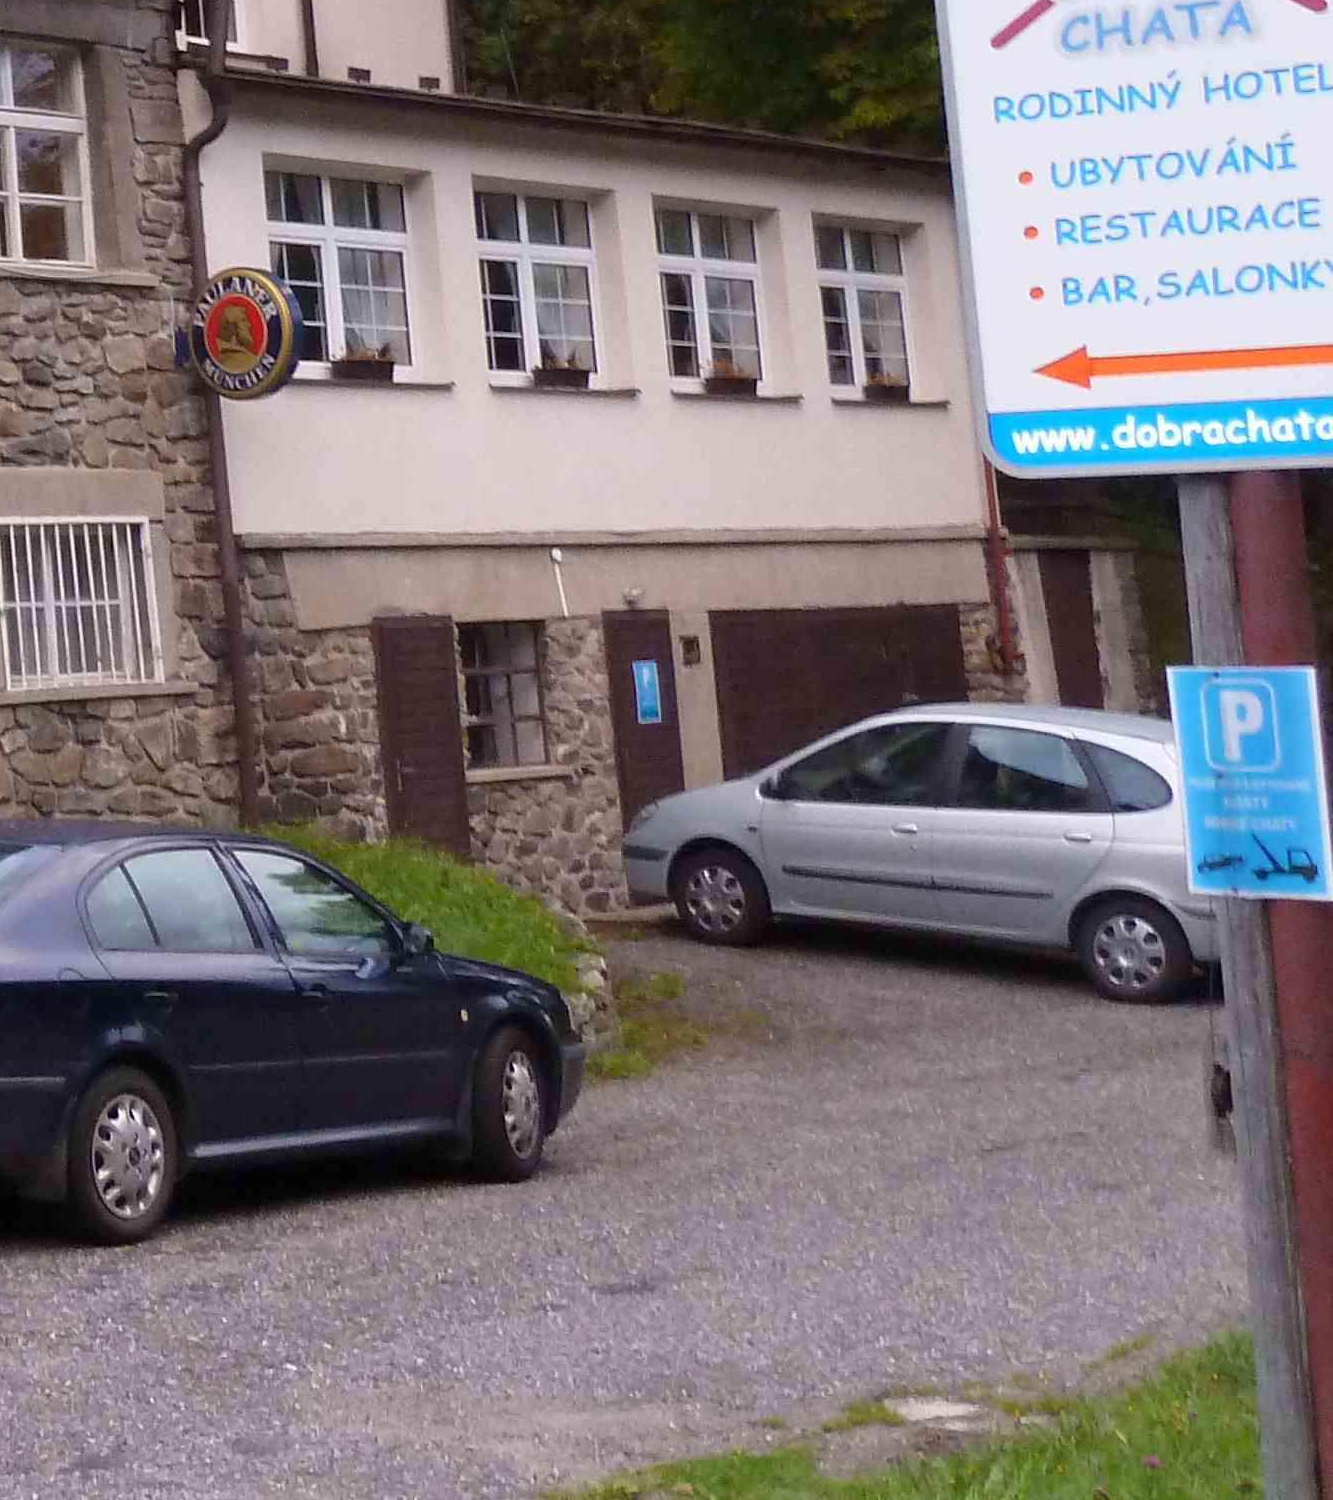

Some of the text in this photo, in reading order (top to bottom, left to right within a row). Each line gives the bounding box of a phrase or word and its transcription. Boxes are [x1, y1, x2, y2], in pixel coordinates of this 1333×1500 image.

[1060, 0, 1254, 54] CHATA
[992, 63, 1333, 123] RODINNÝ HOTEL
[1049, 132, 1298, 188] UBYTOVÁNÍ
[1055, 197, 1321, 246] RESTAURACE
[1218, 690, 1264, 762] P
